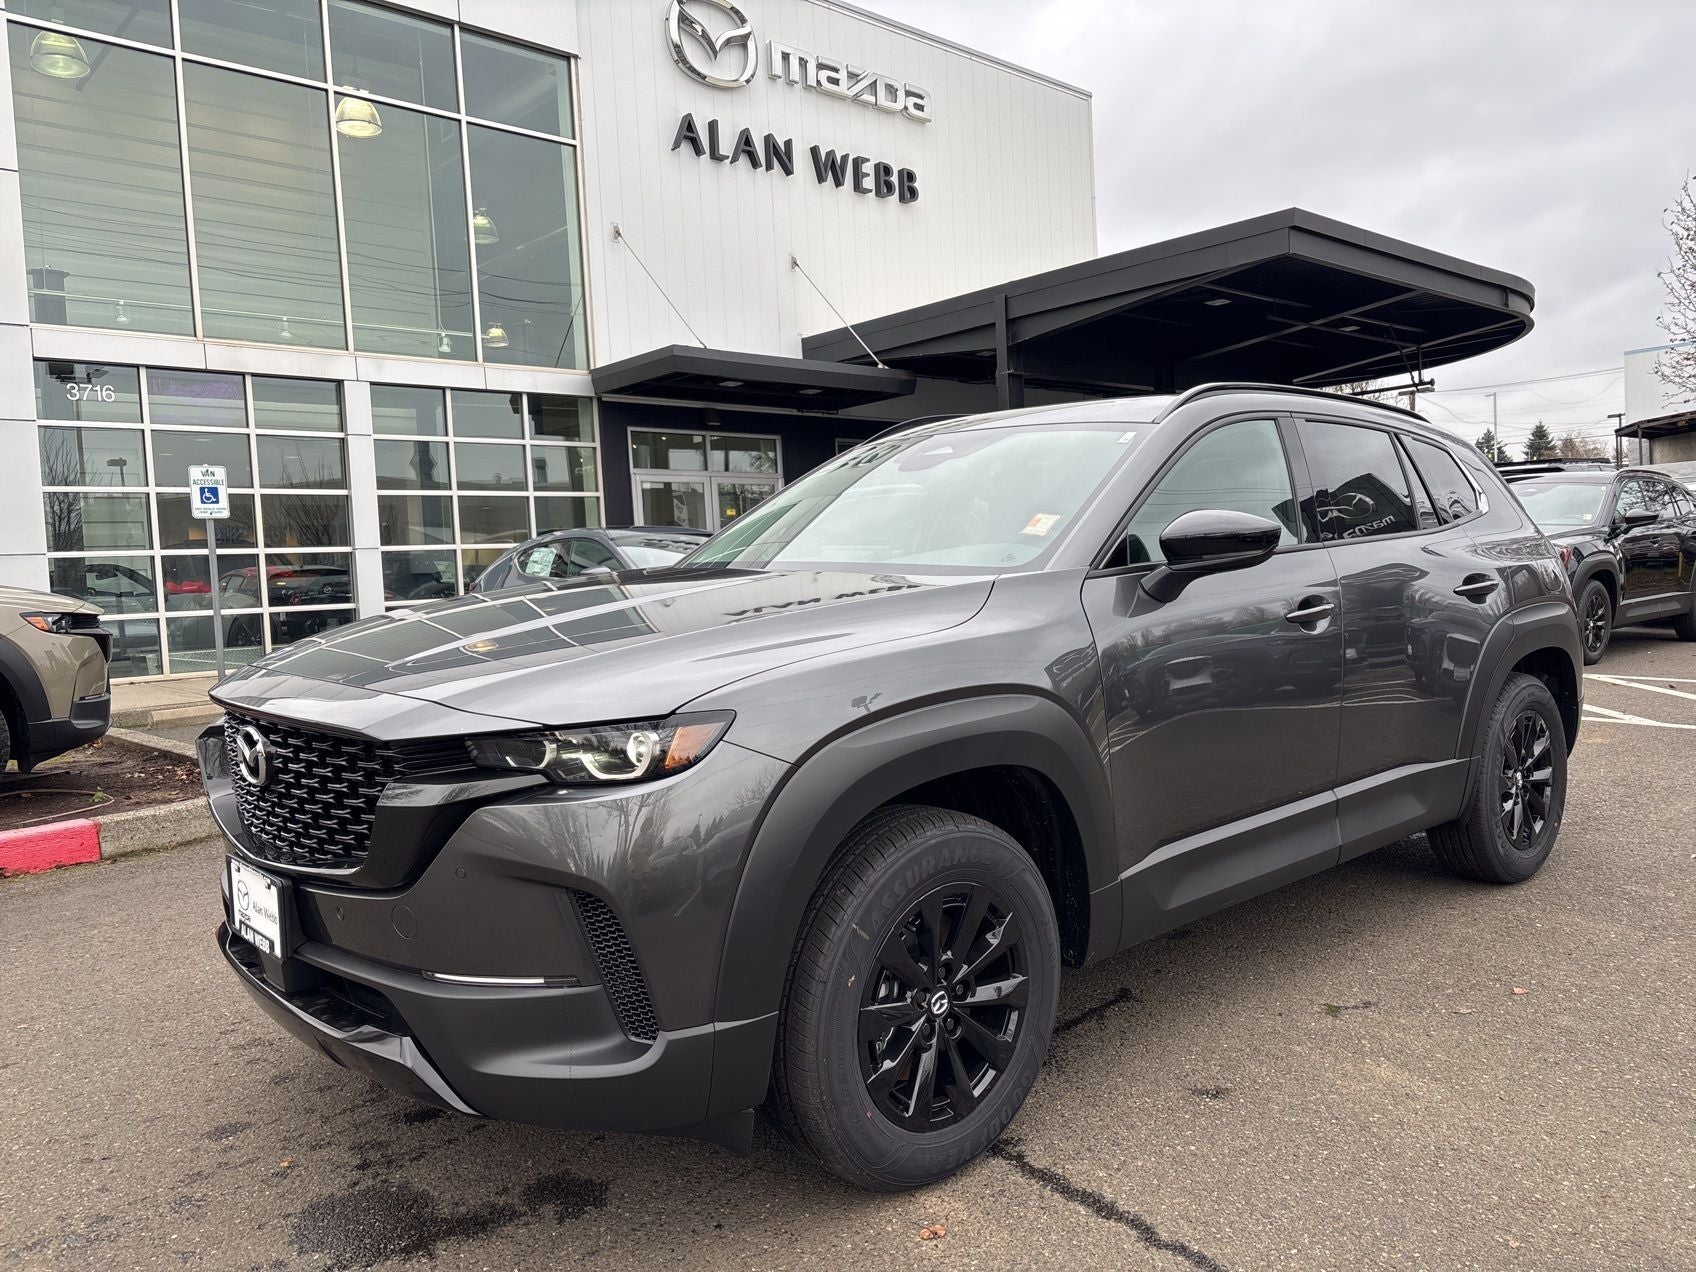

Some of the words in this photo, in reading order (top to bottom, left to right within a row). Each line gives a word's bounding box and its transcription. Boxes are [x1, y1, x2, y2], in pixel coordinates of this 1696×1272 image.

[671, 112, 795, 177] ALAN
[809, 144, 919, 204] WEBB
[66, 383, 115, 402] 3716
[201, 469, 215, 477] VAN
